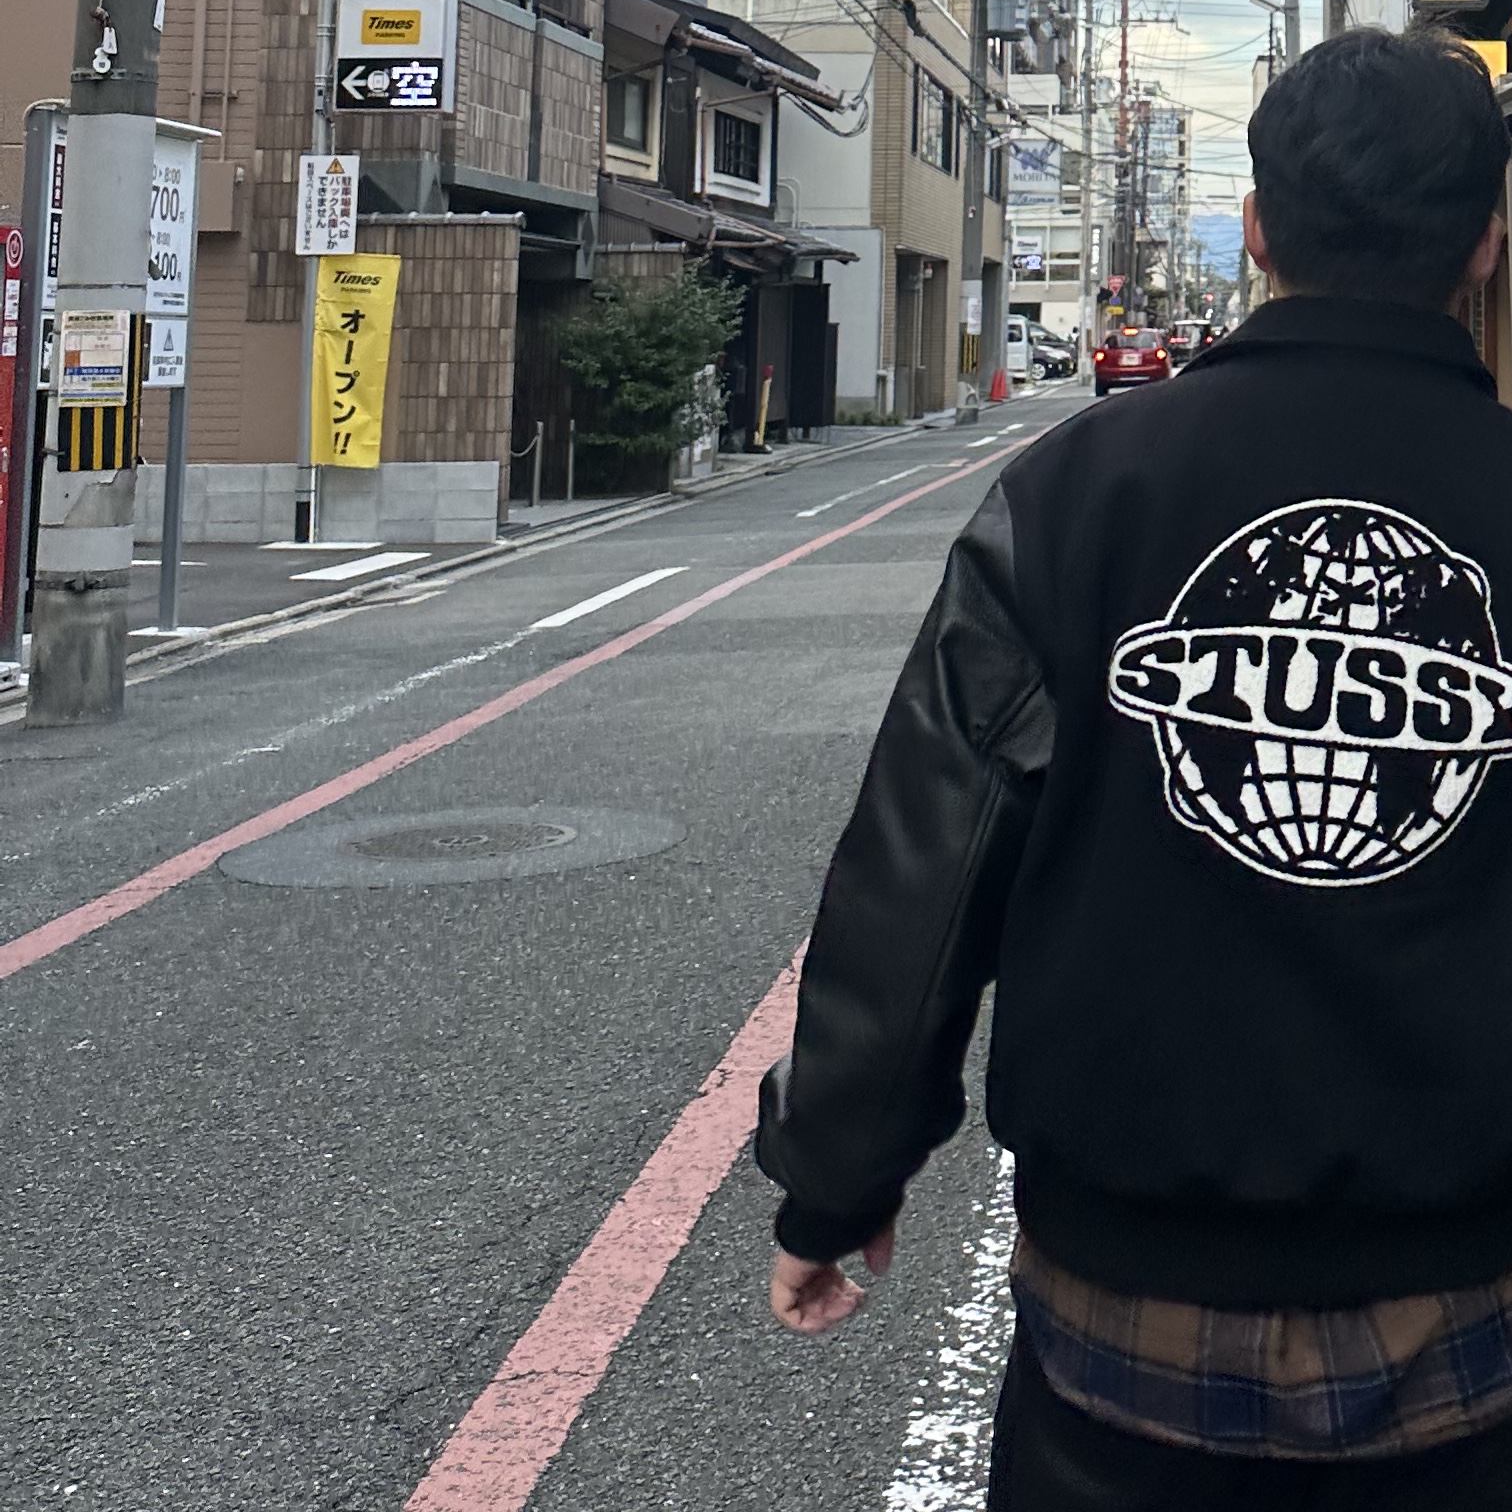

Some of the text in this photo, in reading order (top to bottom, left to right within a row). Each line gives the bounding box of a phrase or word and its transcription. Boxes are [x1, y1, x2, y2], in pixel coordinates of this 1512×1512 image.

[368, 16, 415, 30] Times
[390, 61, 438, 106] 空
[316, 176, 328, 229] できません
[333, 270, 382, 286] Times
